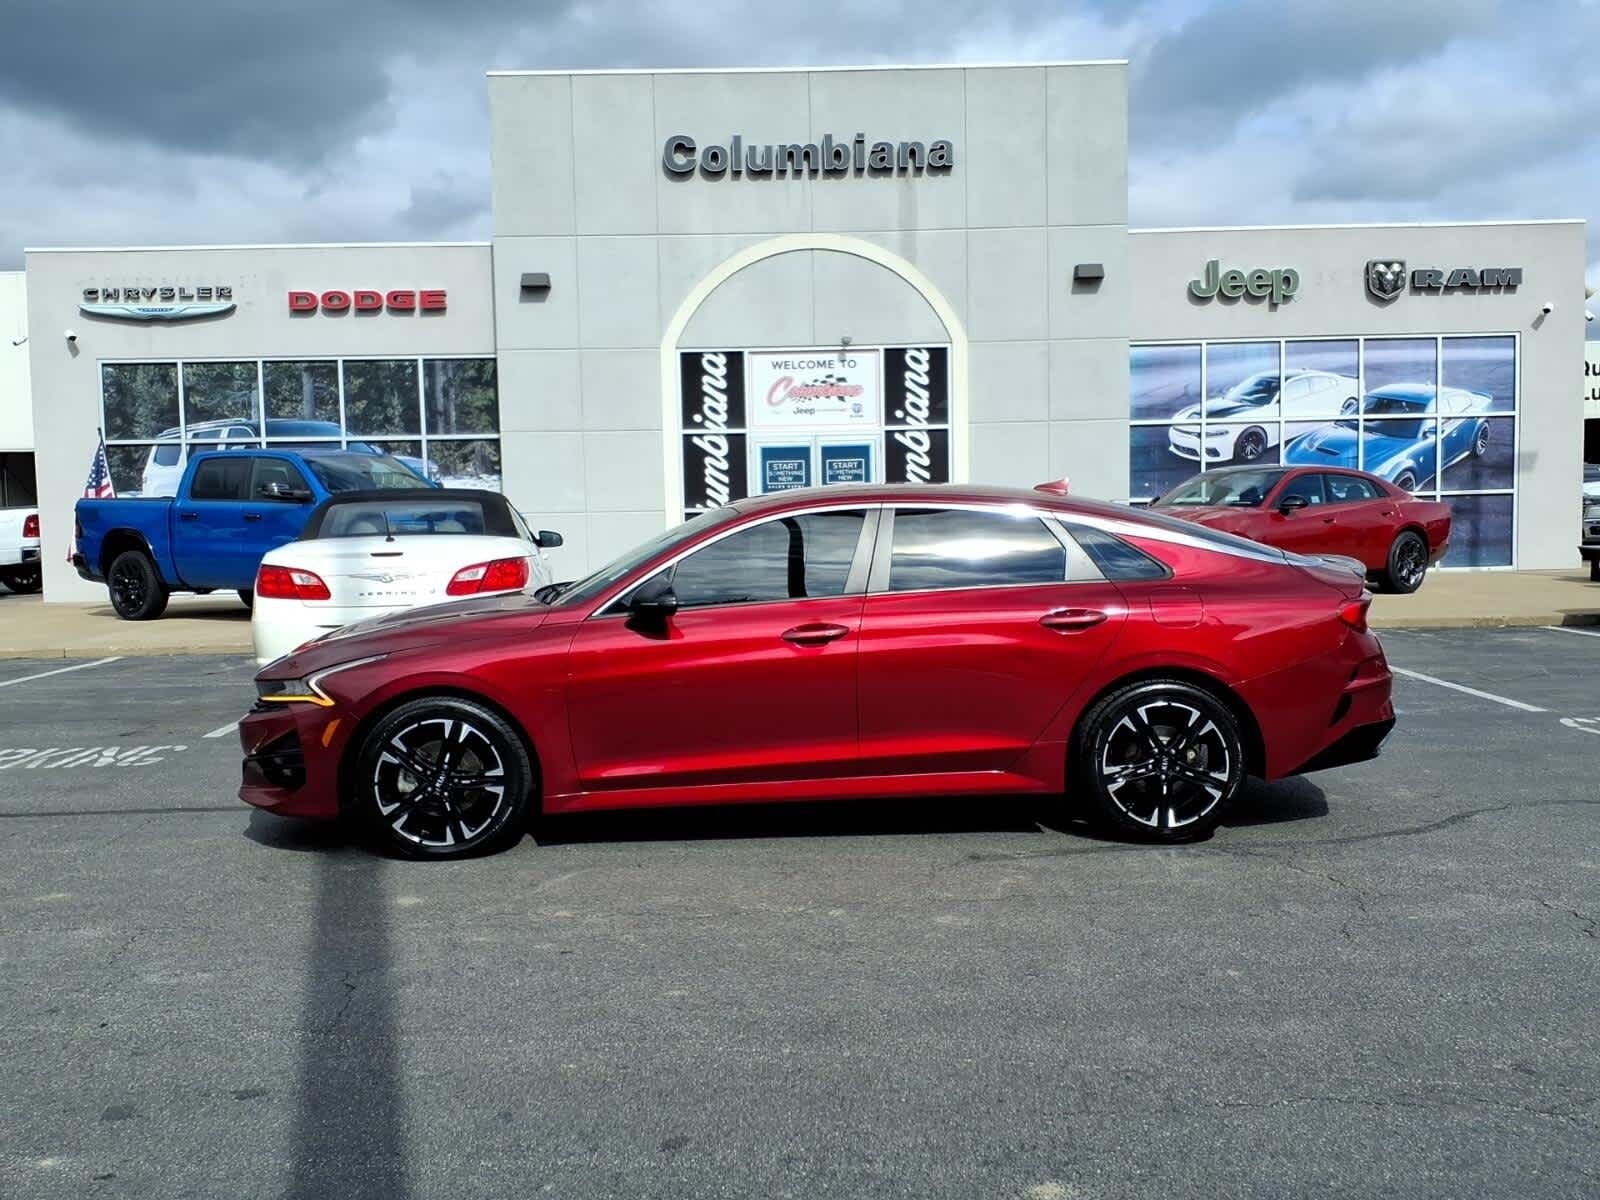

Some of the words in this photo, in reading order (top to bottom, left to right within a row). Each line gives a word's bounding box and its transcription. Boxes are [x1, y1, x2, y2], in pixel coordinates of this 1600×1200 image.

[662, 132, 954, 174] Columbiana
[1188, 259, 1300, 304] Jeep
[1412, 267, 1523, 288] RAM
[82, 286, 233, 301] CHRYSLER
[288, 289, 447, 311] DODGE
[771, 359, 835, 370] WELCOME
[840, 359, 857, 369] TO
[793, 407, 816, 416] Jeep
[692, 352, 730, 511] umbiana
[773, 463, 799, 471] START
[832, 462, 859, 470] START
